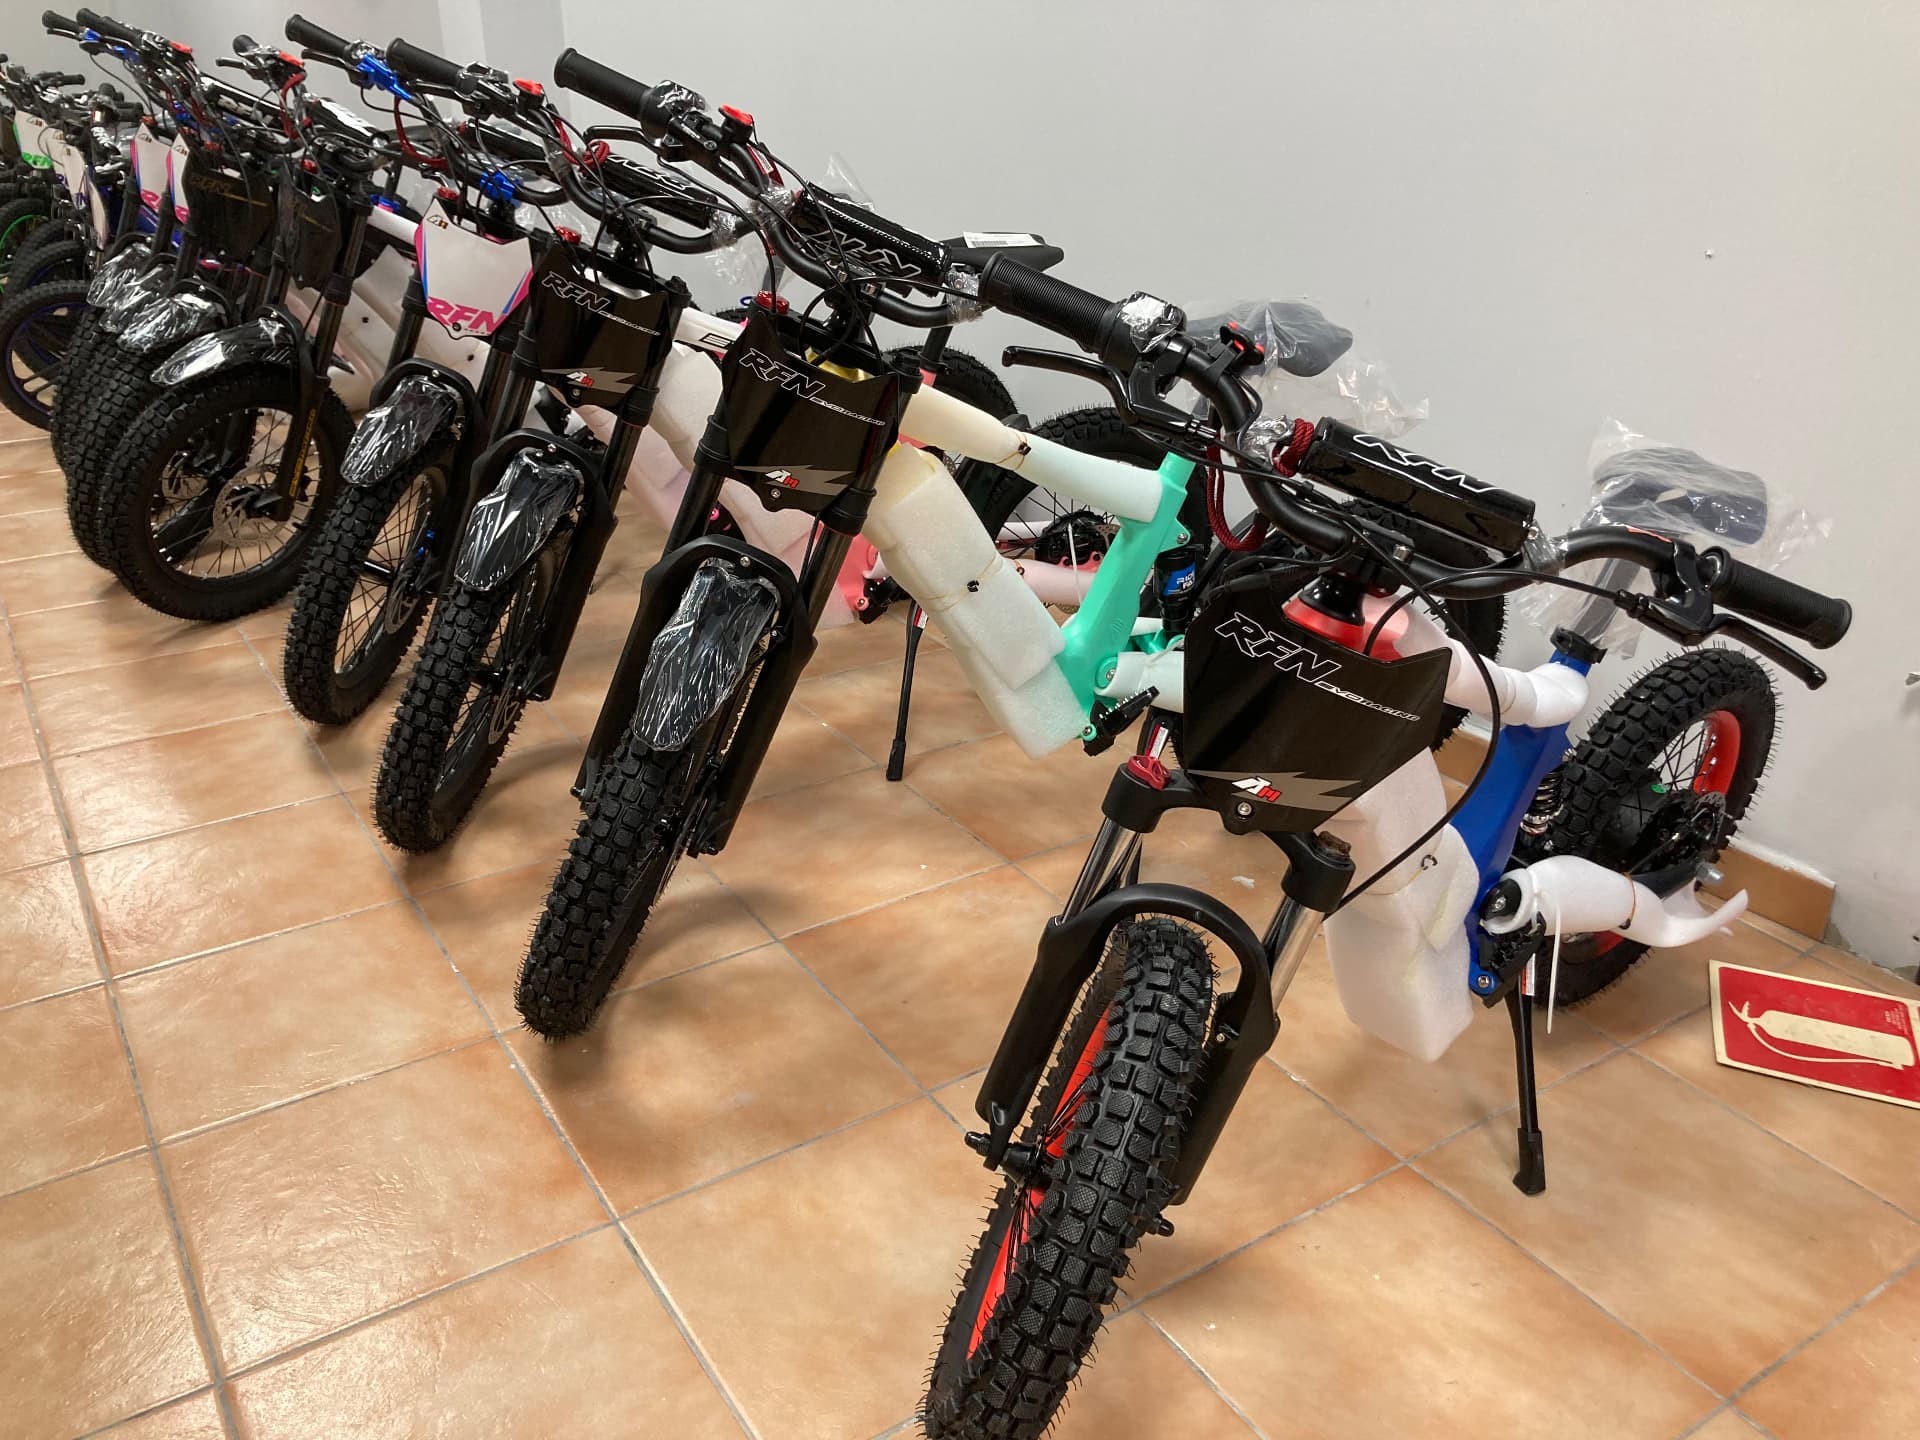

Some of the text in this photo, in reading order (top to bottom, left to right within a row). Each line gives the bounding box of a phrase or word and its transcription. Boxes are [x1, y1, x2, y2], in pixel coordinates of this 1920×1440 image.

[541, 271, 611, 312] RFN
[427, 296, 507, 335] RFN
[739, 347, 826, 398] RFN
[1215, 612, 1342, 683] RFN
